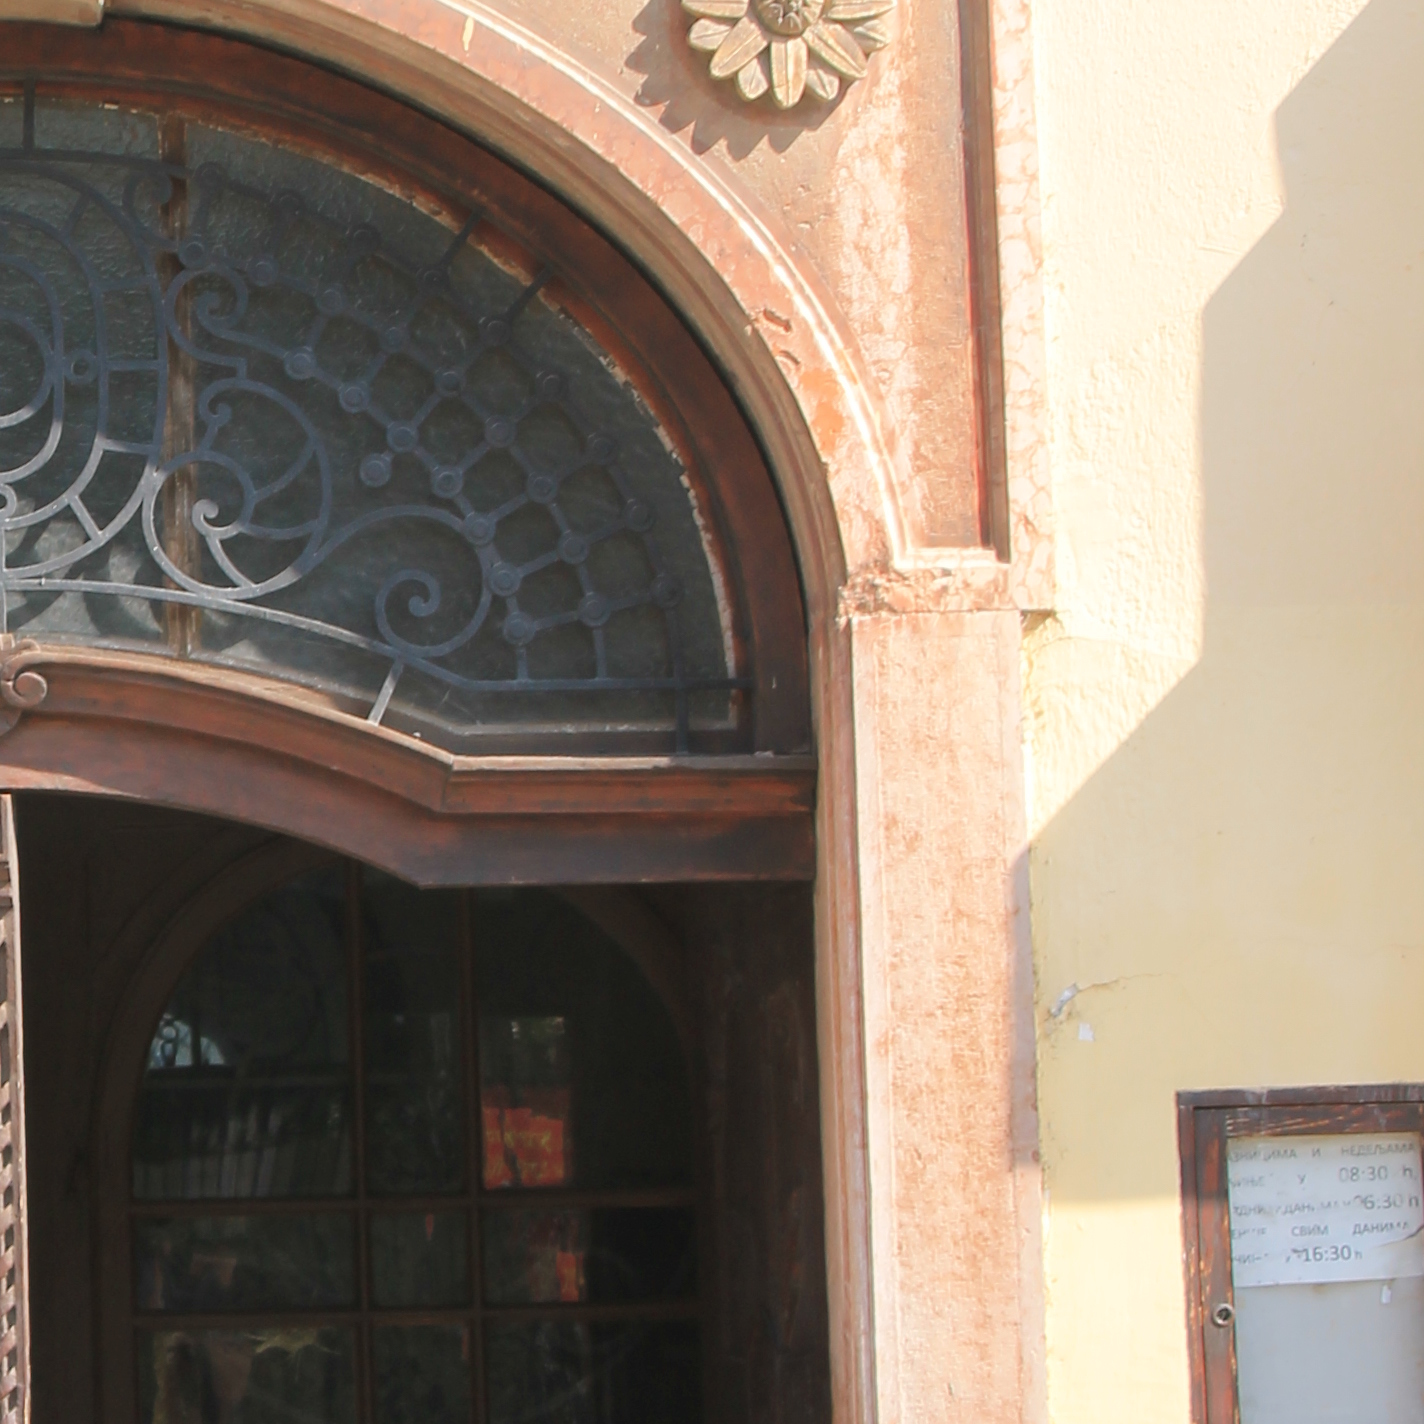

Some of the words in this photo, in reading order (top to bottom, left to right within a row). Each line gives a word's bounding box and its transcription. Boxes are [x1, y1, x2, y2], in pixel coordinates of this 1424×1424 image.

[1311, 1147, 1321, 1159] И
[1292, 1223, 1329, 1237] СВИМ
[1304, 1244, 1351, 1264] 16:30
